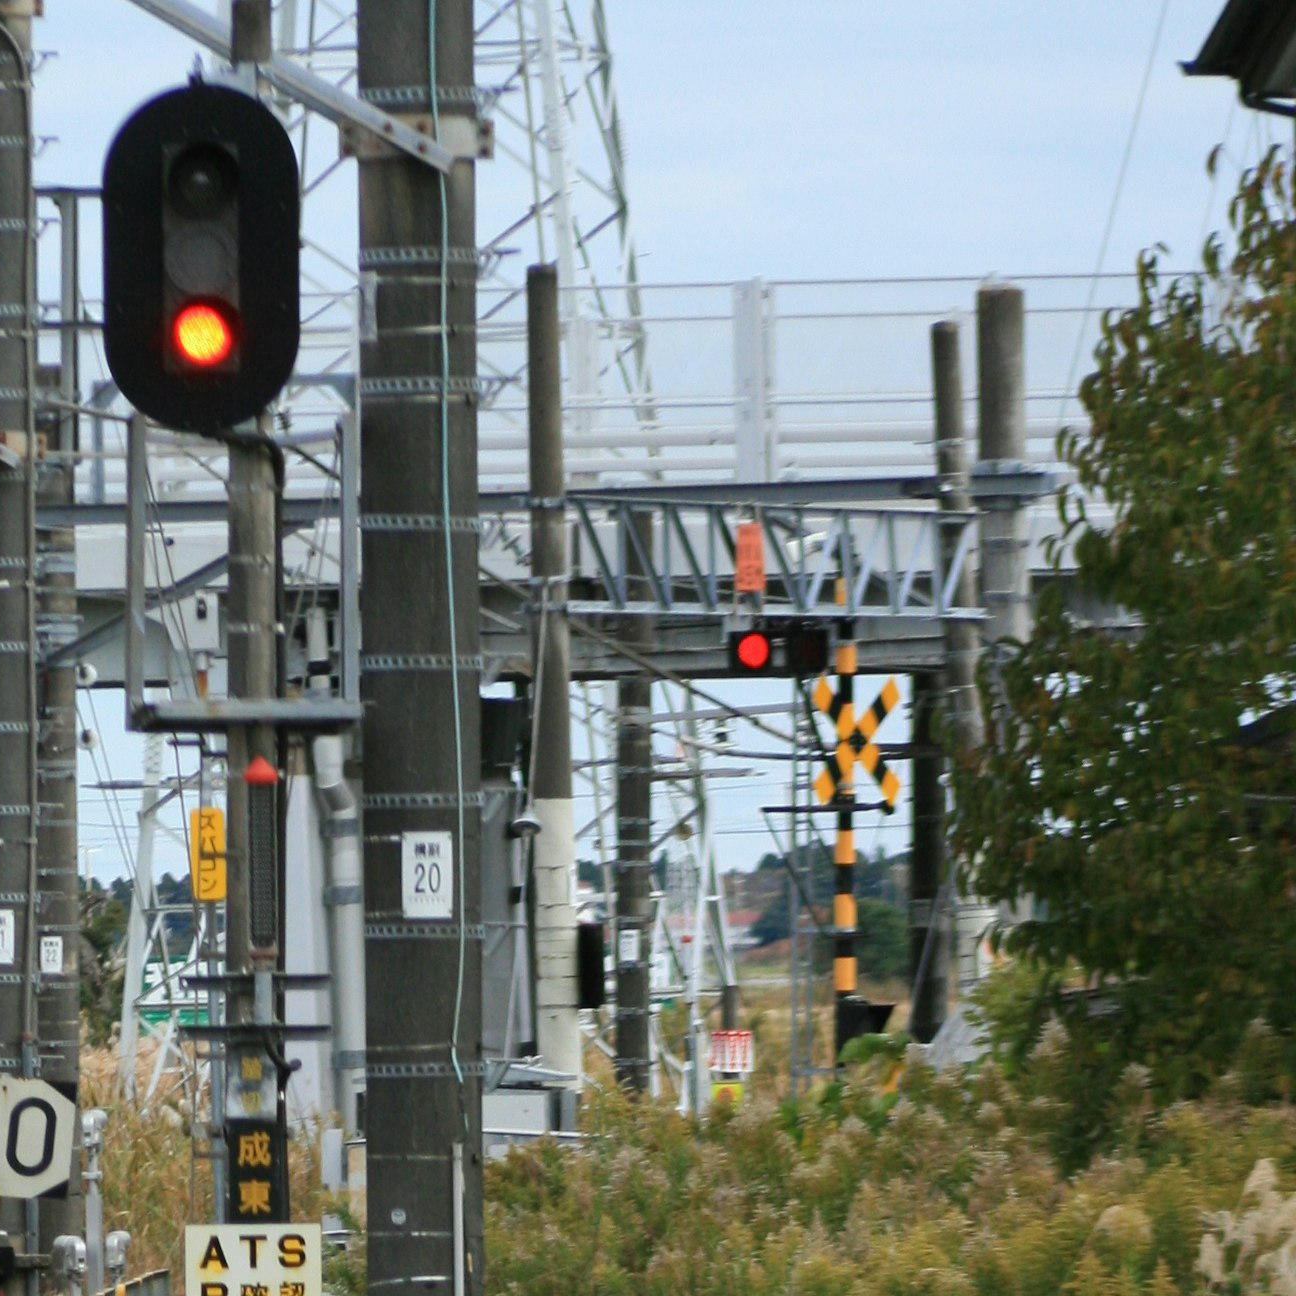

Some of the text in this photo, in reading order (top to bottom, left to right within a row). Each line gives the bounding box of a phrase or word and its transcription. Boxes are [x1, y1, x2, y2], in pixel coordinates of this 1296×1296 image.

[414, 862, 441, 893] 20
[238, 1131, 272, 1214] 成東
[200, 1234, 306, 1269] ATS
